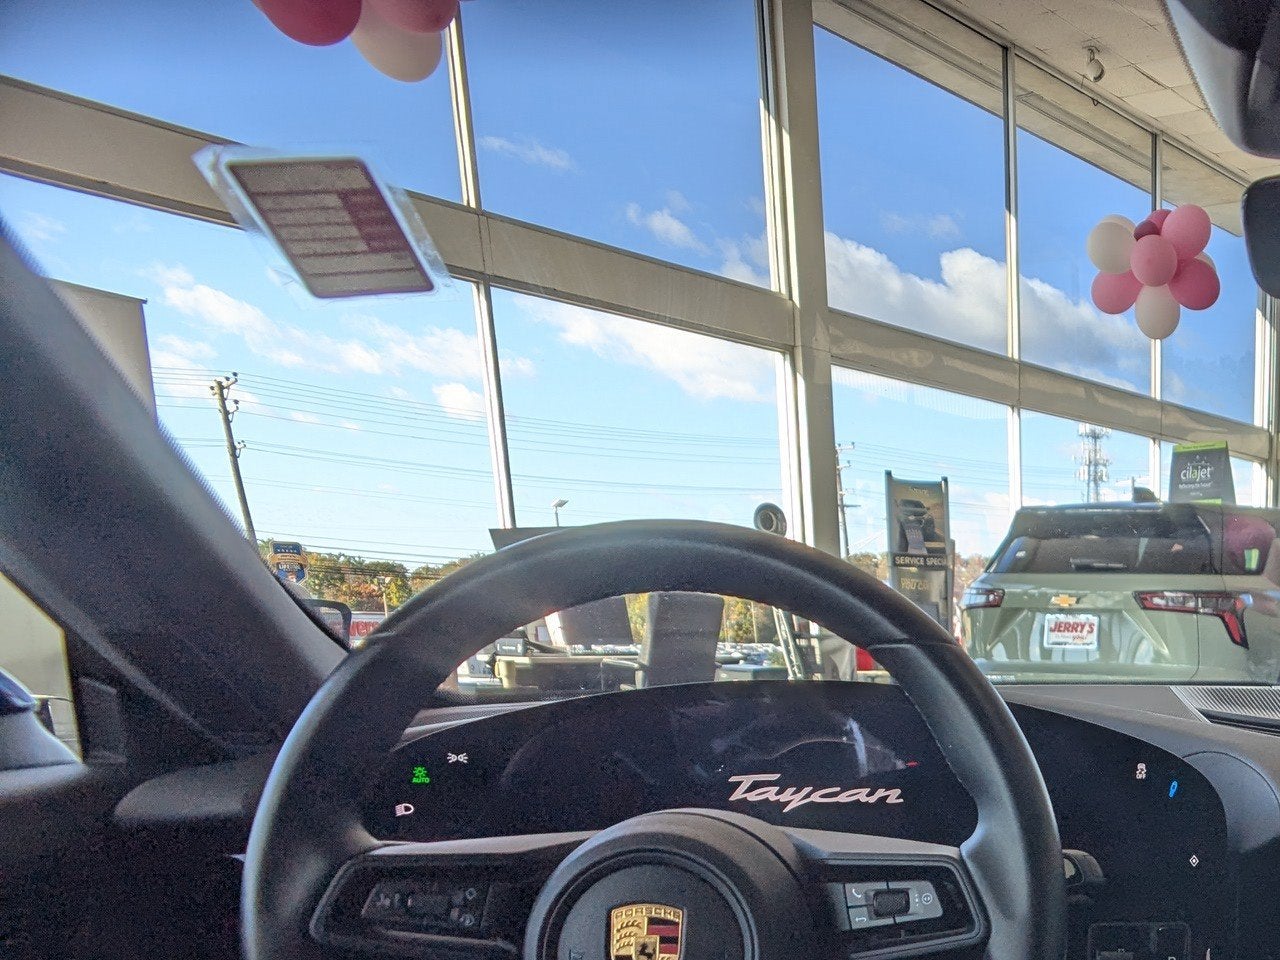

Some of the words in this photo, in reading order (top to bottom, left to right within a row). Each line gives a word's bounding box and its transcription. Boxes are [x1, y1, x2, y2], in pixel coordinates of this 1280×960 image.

[1180, 466, 1211, 482] cilajet
[895, 555, 924, 566] SERVICE
[728, 774, 904, 812] Taycan
[615, 907, 681, 920] PORSCHE
